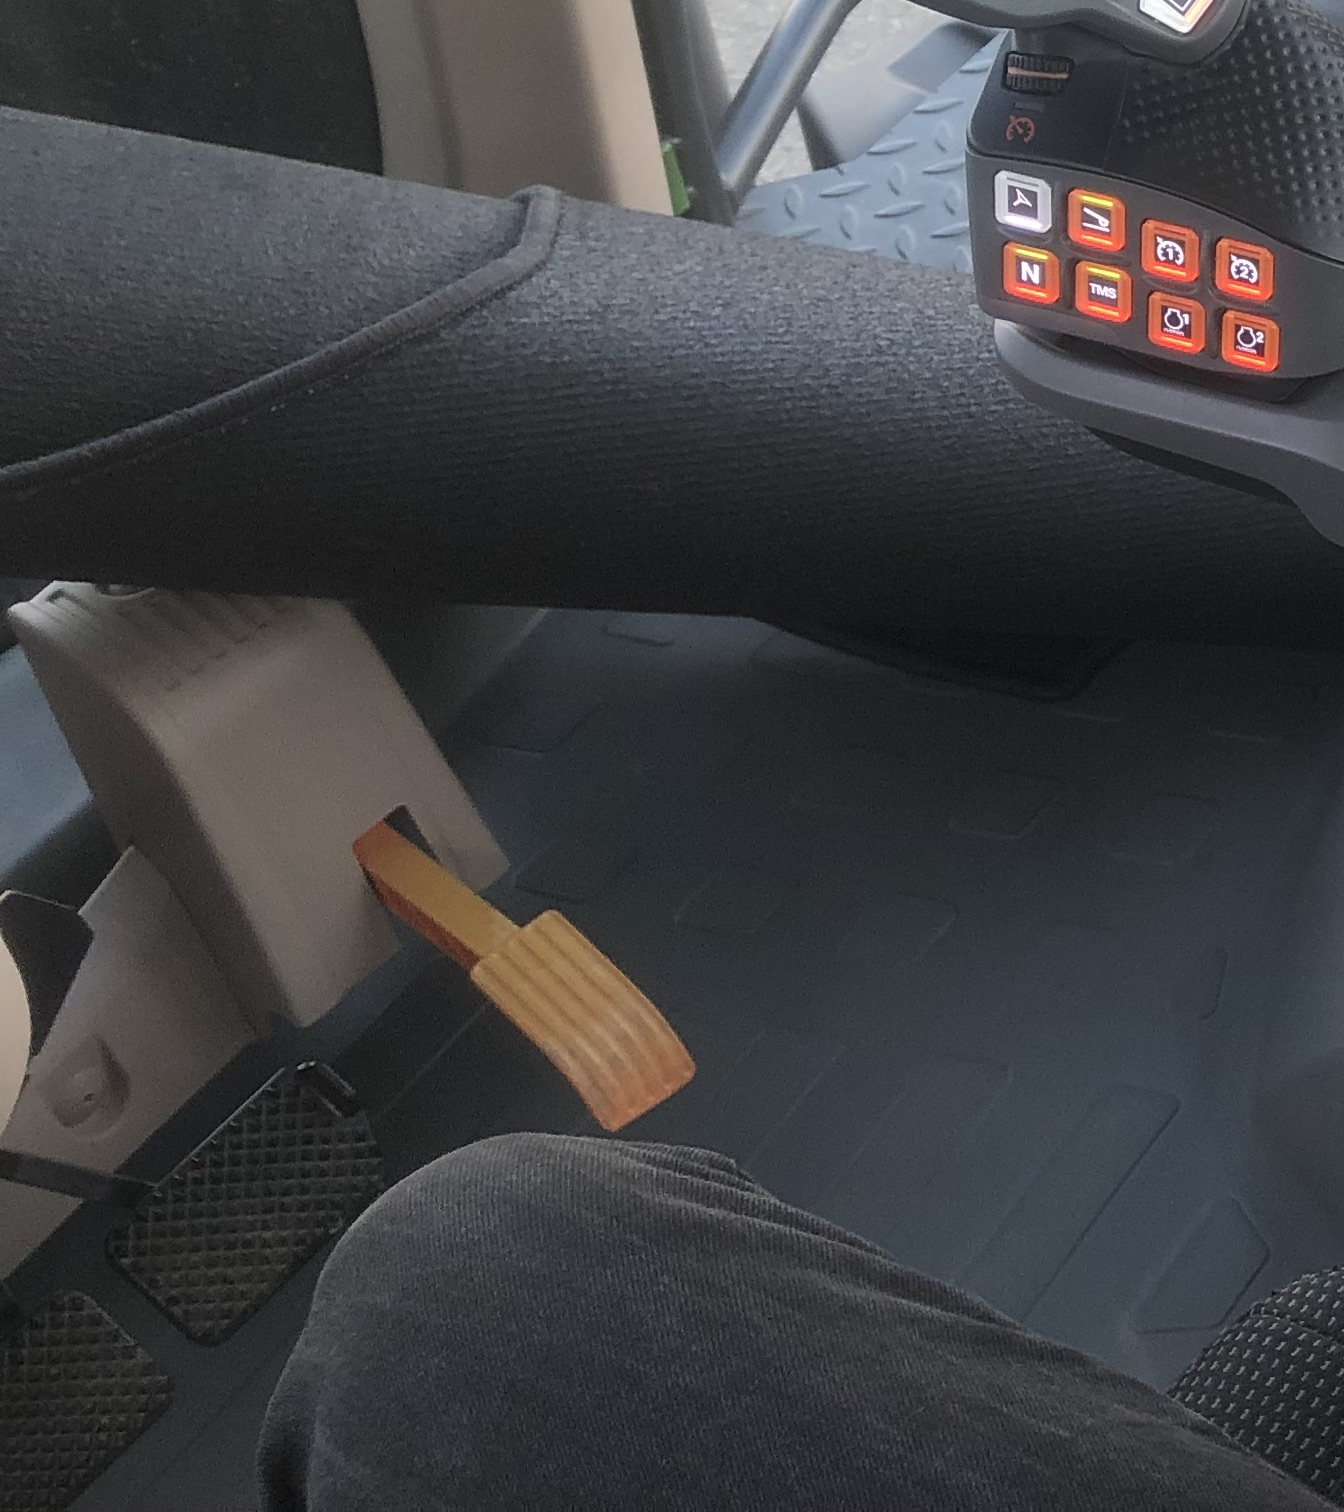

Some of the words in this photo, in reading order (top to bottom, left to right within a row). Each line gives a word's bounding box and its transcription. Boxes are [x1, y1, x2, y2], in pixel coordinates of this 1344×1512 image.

[1020, 261, 1040, 284] N
[1238, 266, 1249, 278] 2
[1089, 281, 1117, 300] TMS
[1255, 331, 1264, 343] 2
